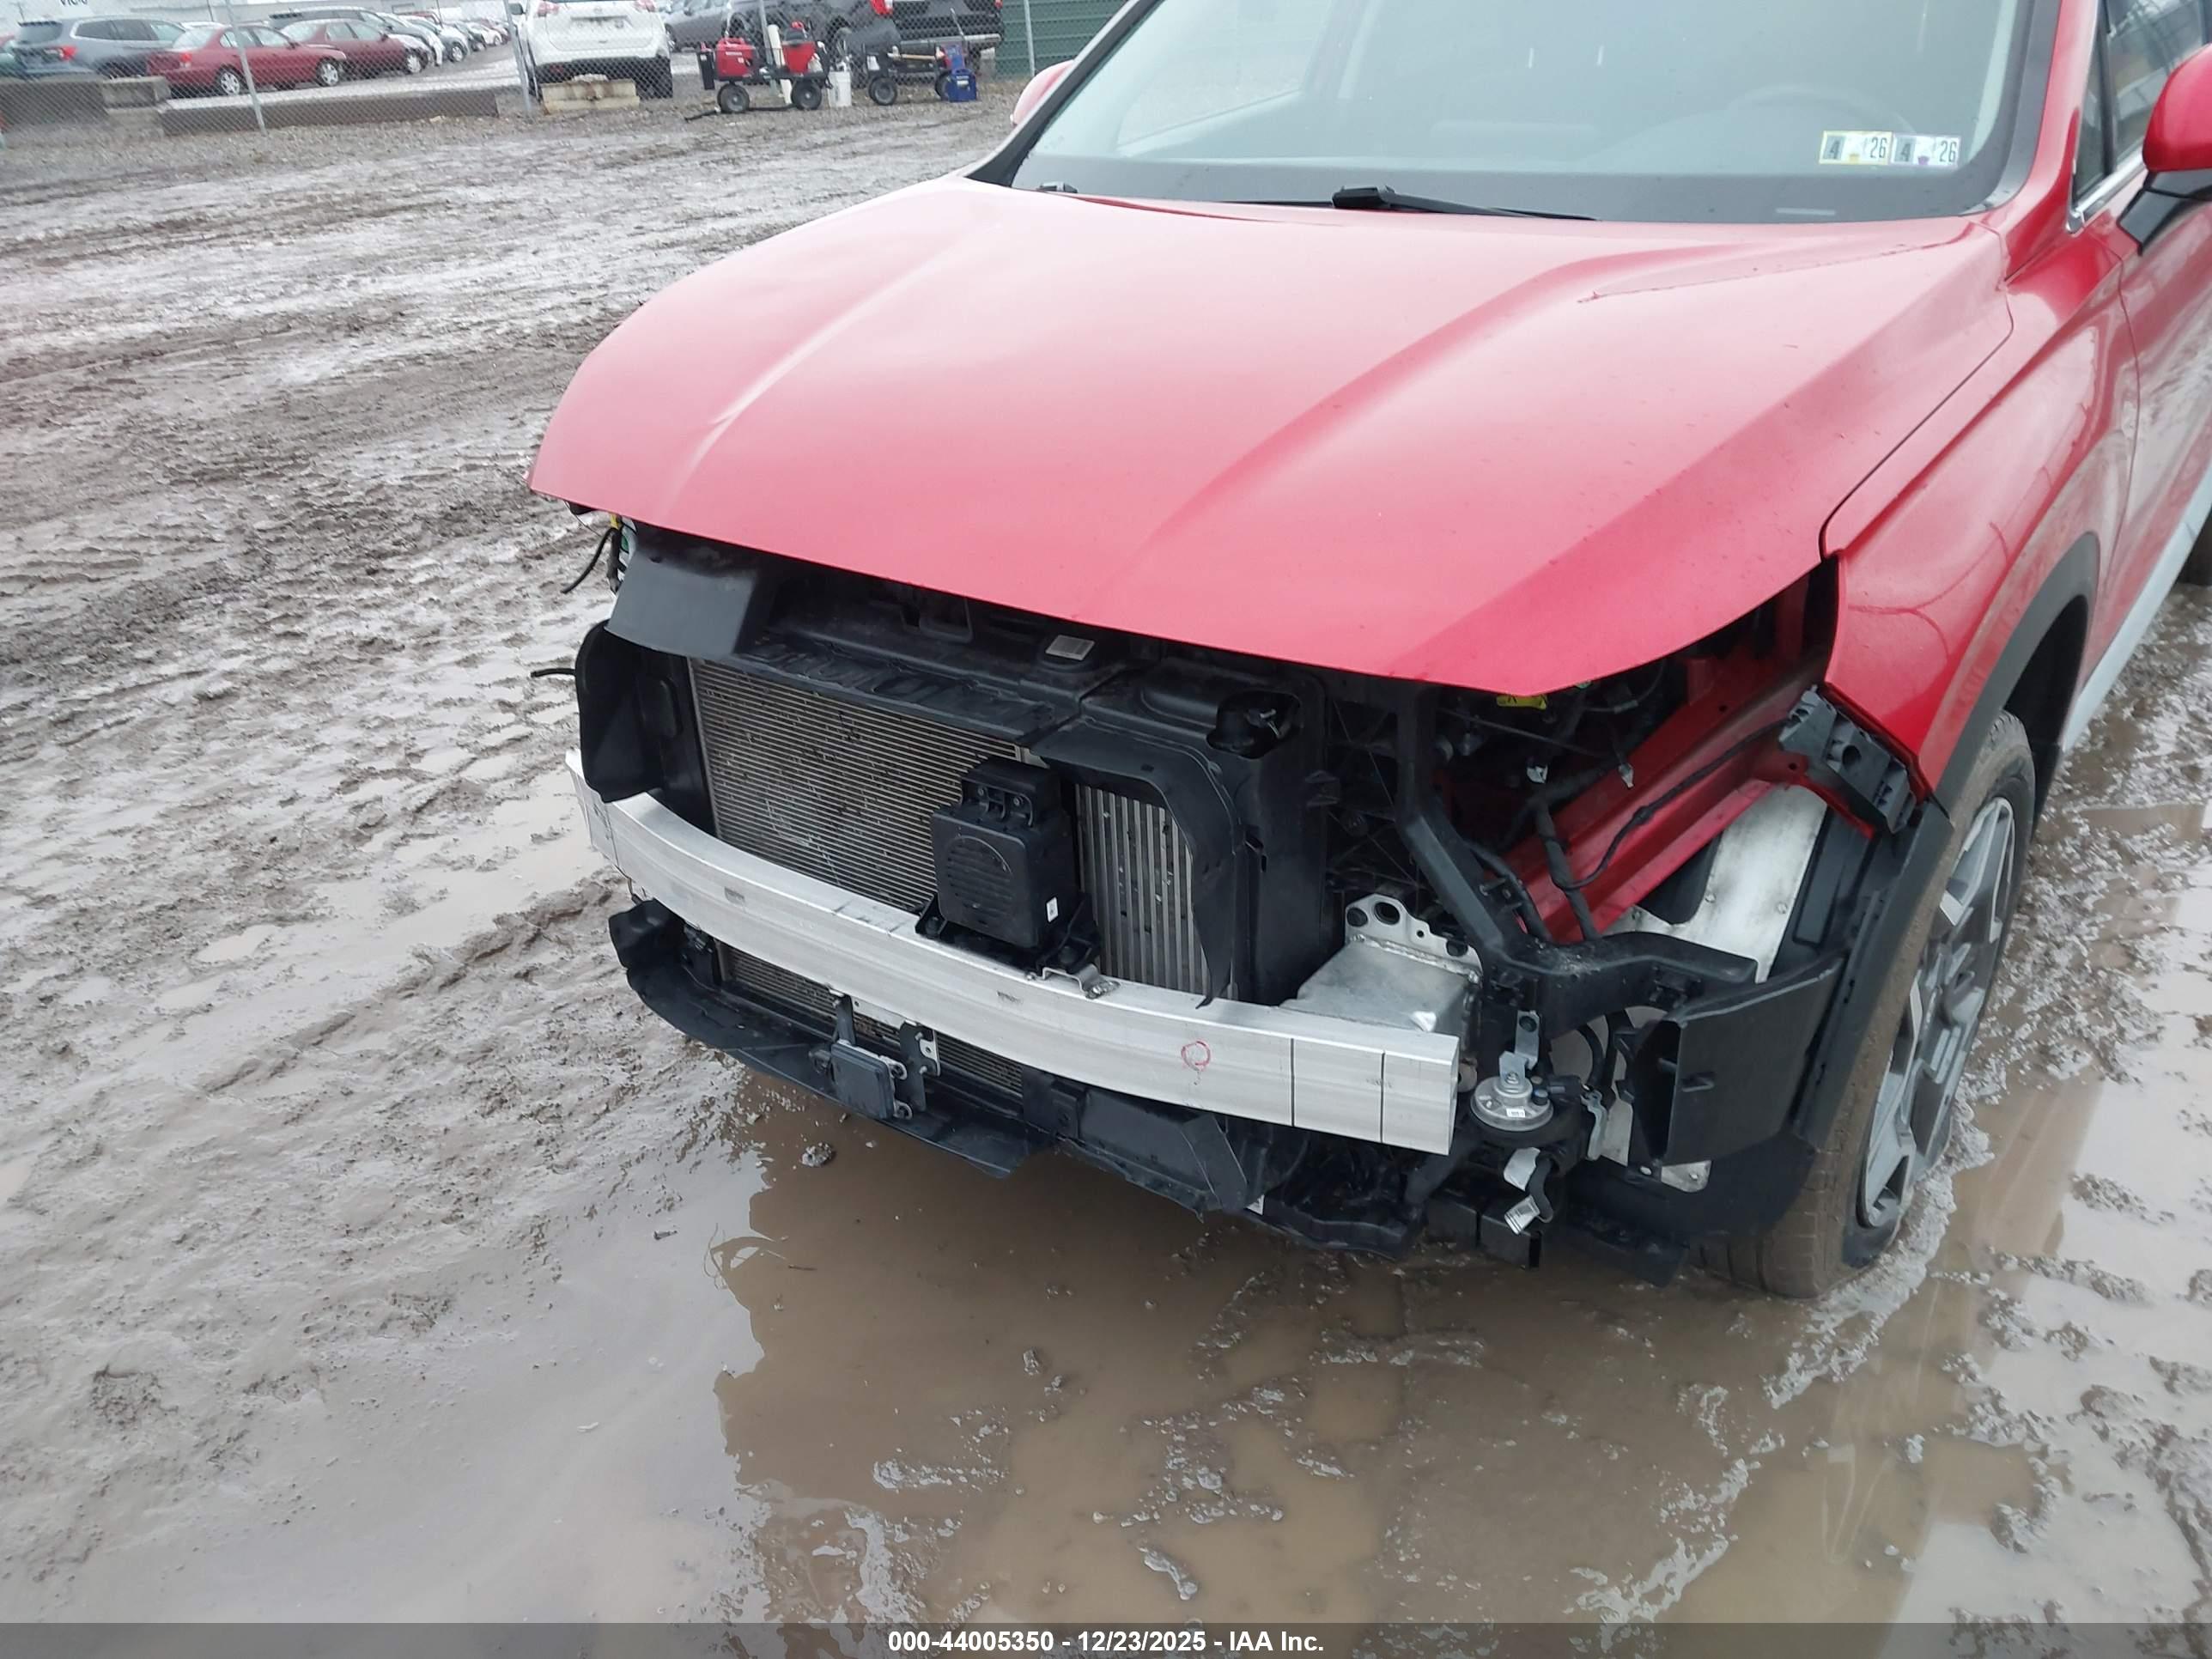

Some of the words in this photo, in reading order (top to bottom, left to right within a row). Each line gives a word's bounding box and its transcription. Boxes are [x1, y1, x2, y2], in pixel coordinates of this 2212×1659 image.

[1829, 140, 1840, 160] 4
[1869, 137, 1887, 159] 26
[1899, 143, 1911, 162] 4
[1939, 140, 1958, 163] 26
